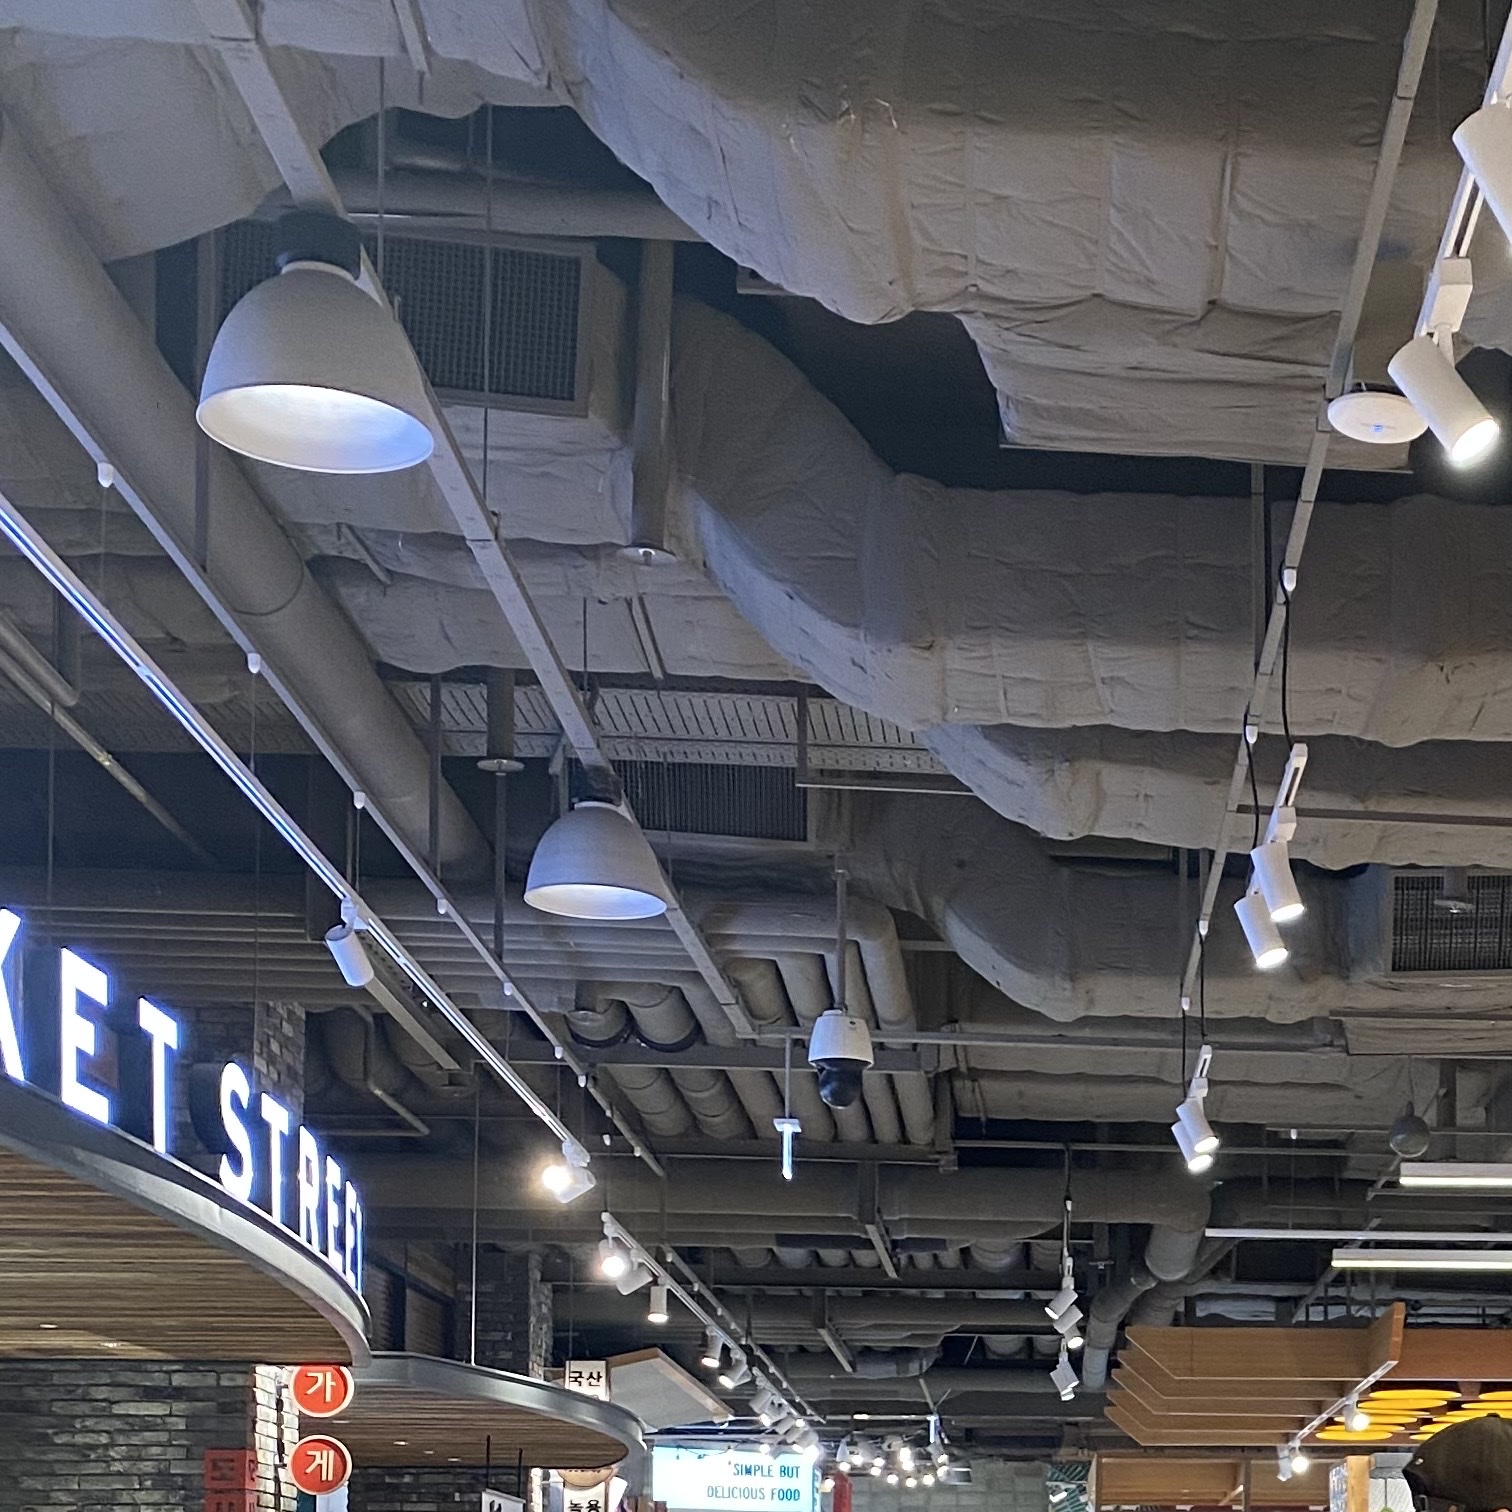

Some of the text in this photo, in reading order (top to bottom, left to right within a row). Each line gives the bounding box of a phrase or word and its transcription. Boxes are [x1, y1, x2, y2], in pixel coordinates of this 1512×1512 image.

[568, 1370, 603, 1388] 국산
[733, 1463, 801, 1479] SIMPLE BUT
[706, 1485, 801, 1501] DELICIOUS FOOD
